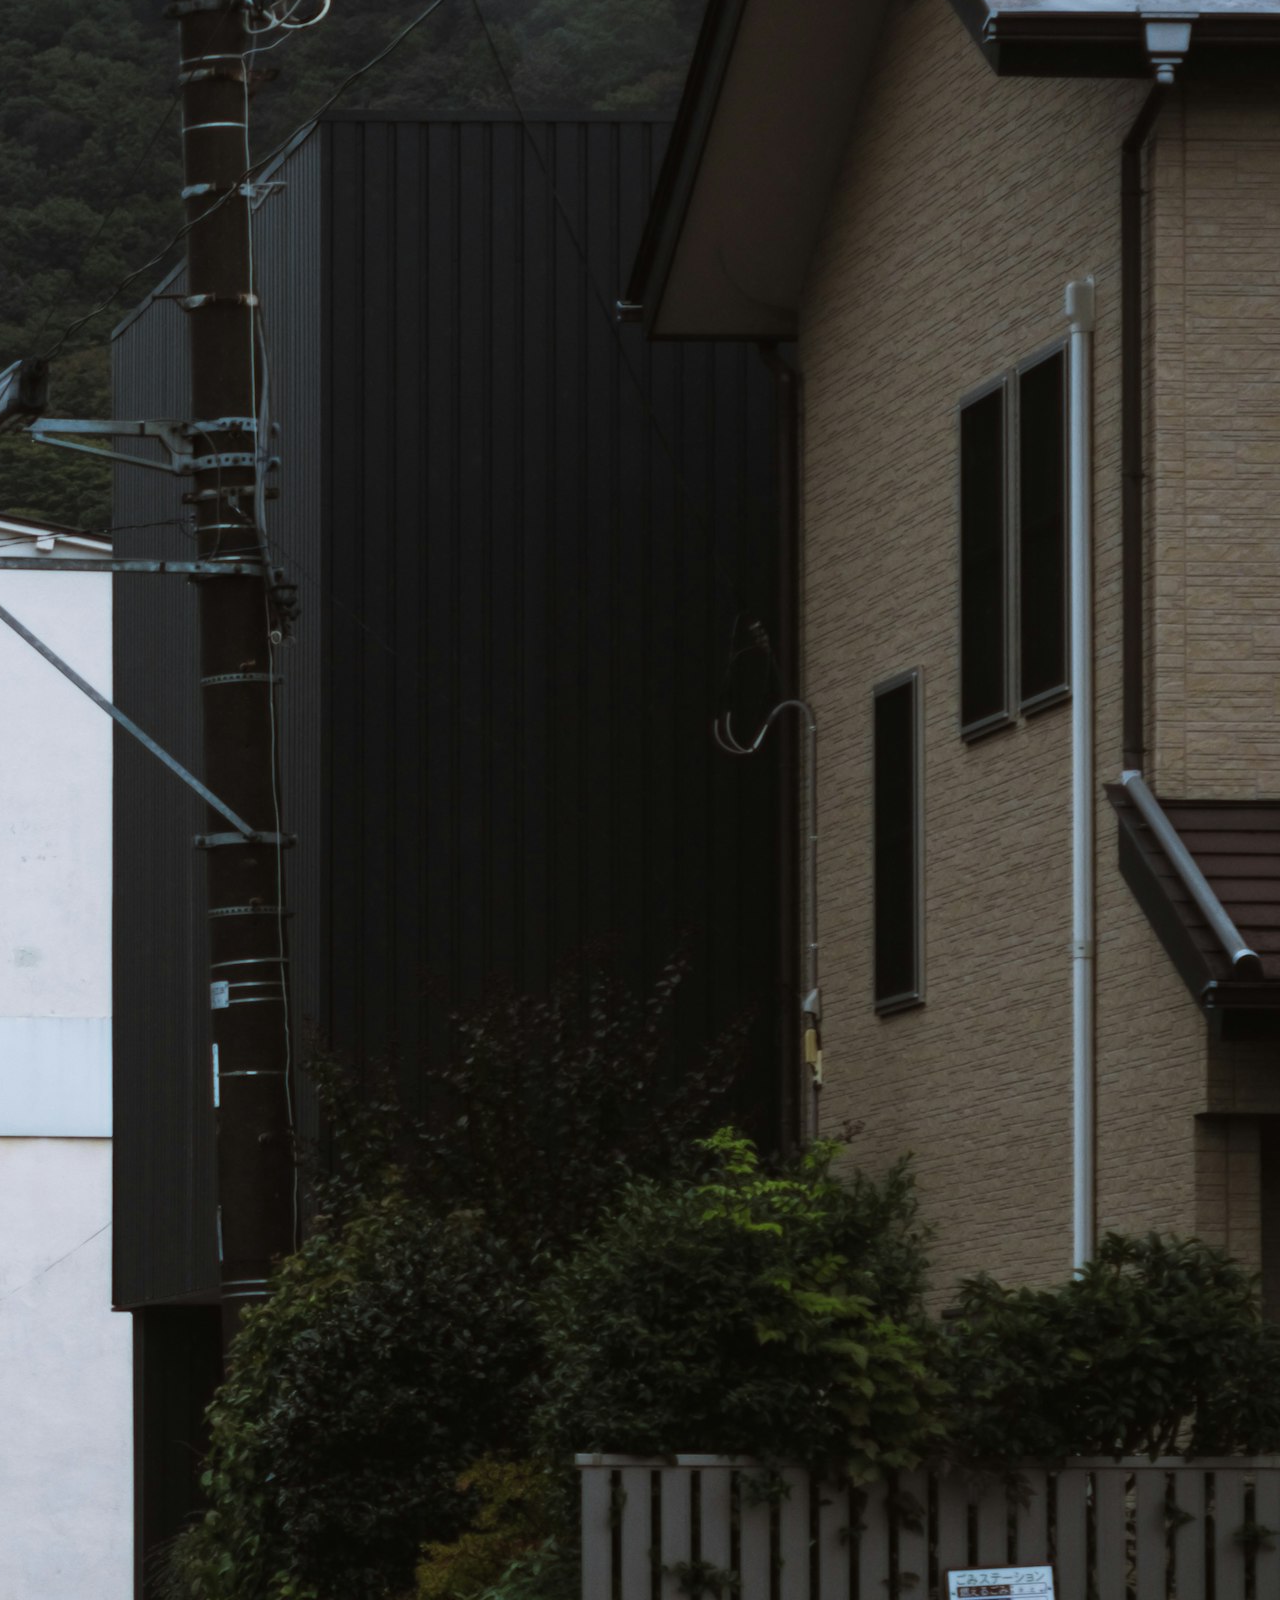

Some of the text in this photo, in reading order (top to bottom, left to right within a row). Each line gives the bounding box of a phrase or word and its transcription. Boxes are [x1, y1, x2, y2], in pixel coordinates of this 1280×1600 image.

[956, 1572, 1045, 1586] ごみステーション
